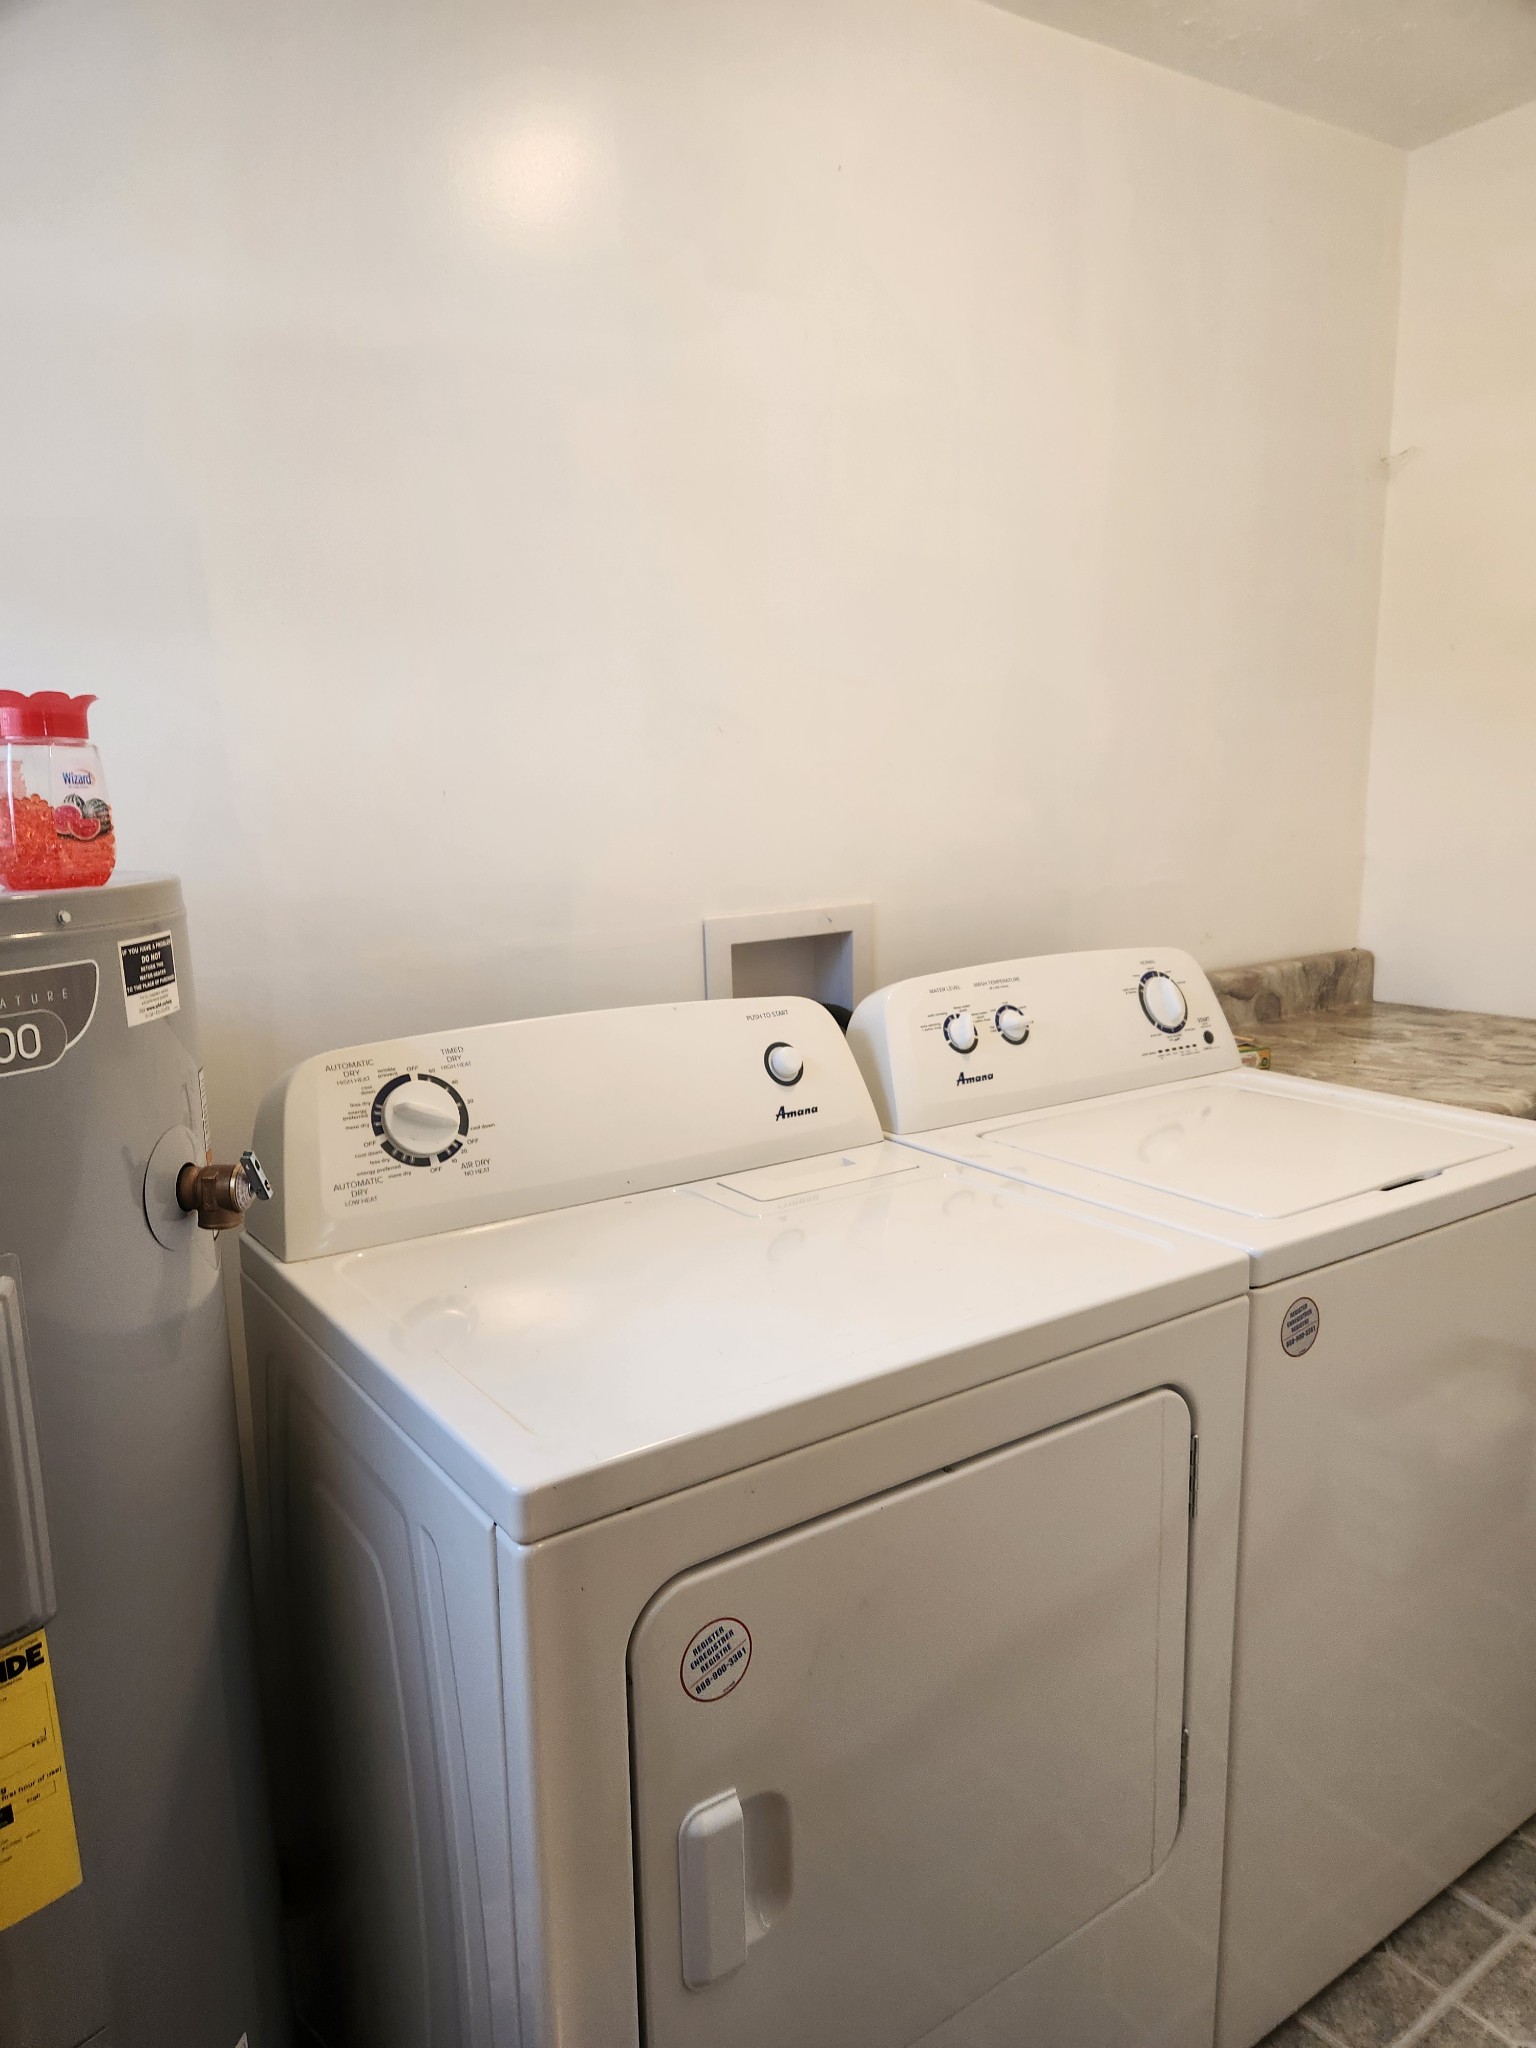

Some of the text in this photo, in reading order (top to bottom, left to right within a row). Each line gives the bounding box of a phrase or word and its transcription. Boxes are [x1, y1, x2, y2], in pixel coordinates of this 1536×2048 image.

[63, 771, 92, 785] Wizard
[128, 946, 139, 955] YOU
[141, 951, 160, 964] DO NOT
[746, 1013, 762, 1021] PUSH
[440, 1046, 464, 1055] TIMED
[326, 1059, 374, 1072] AUTOMATIC
[446, 1055, 462, 1063] DRY
[343, 1069, 360, 1078] DRY
[957, 1072, 994, 1086] Amana
[776, 1106, 818, 1121] Amana
[461, 1158, 490, 1170] AIR DRY
[333, 1176, 384, 1192] AUTOMATIC
[351, 1188, 368, 1198] DRY
[345, 1196, 377, 1207] LOW HEAT
[693, 1626, 725, 1657] REGISTER
[690, 1629, 734, 1670] ENREGISTRER
[700, 1643, 732, 1674] REGISTRE
[695, 1647, 747, 1694] 888-900-3381
[18, 1780, 35, 1792] hour
